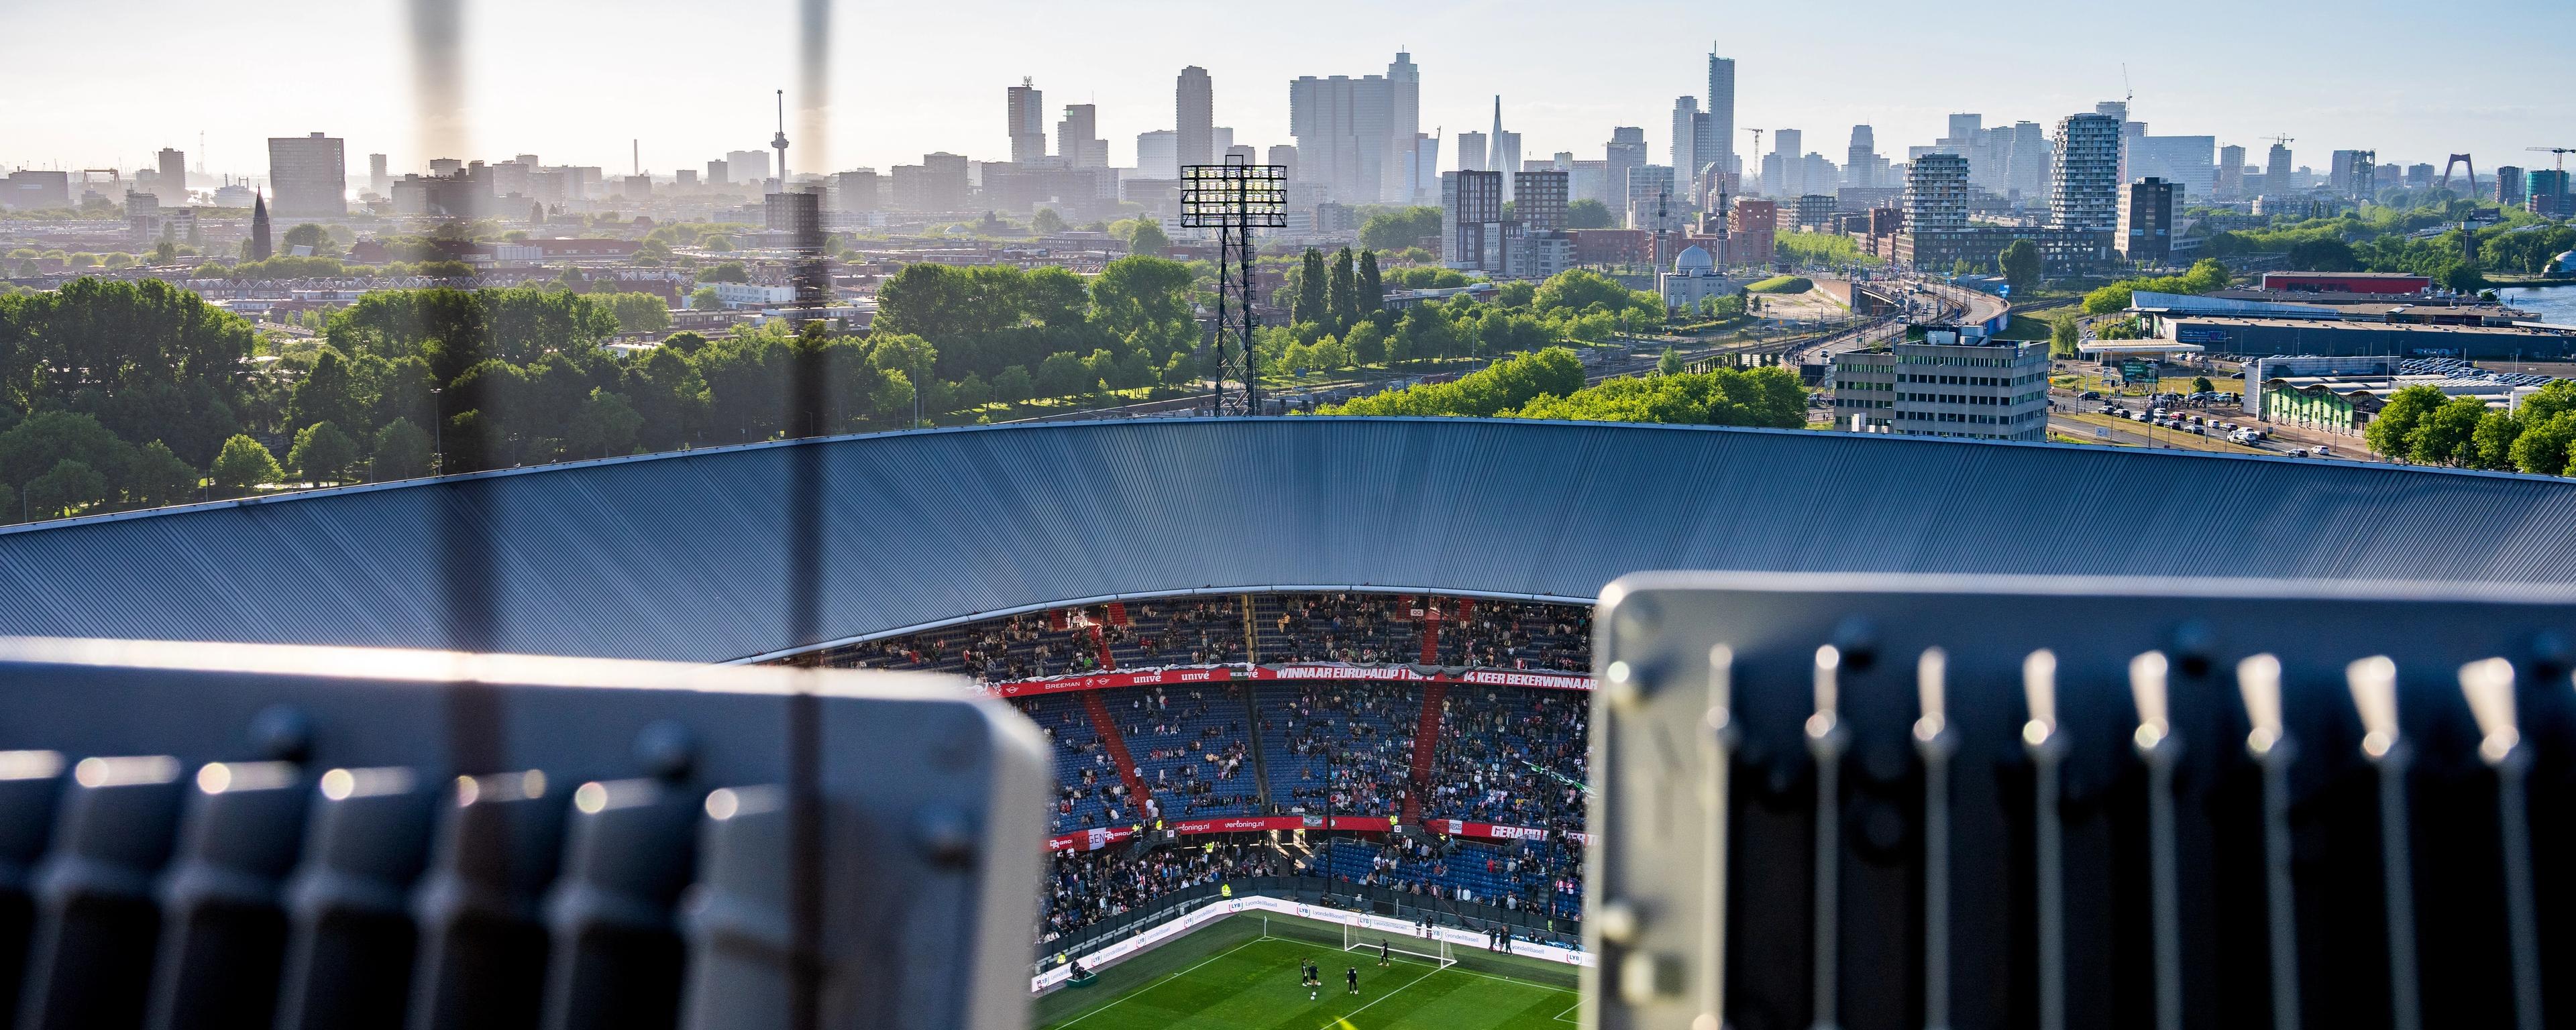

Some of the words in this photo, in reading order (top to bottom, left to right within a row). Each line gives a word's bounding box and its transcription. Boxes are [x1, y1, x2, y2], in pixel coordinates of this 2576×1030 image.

[1181, 671, 1210, 681] univé
[1277, 668, 1332, 679] WINNAAR
[1332, 668, 1397, 679] EUROPACUP
[1133, 674, 1162, 683] univé
[1464, 671, 1475, 682] 14
[1477, 672, 1505, 684] KEER
[1506, 673, 1599, 690] BEKERWINNAAR
[1045, 681, 1080, 689] BREEMAN
[1225, 820, 1264, 828] verloning.nl
[1491, 825, 1541, 841] GERARD
[1512, 945, 1544, 954] yondellBasell
